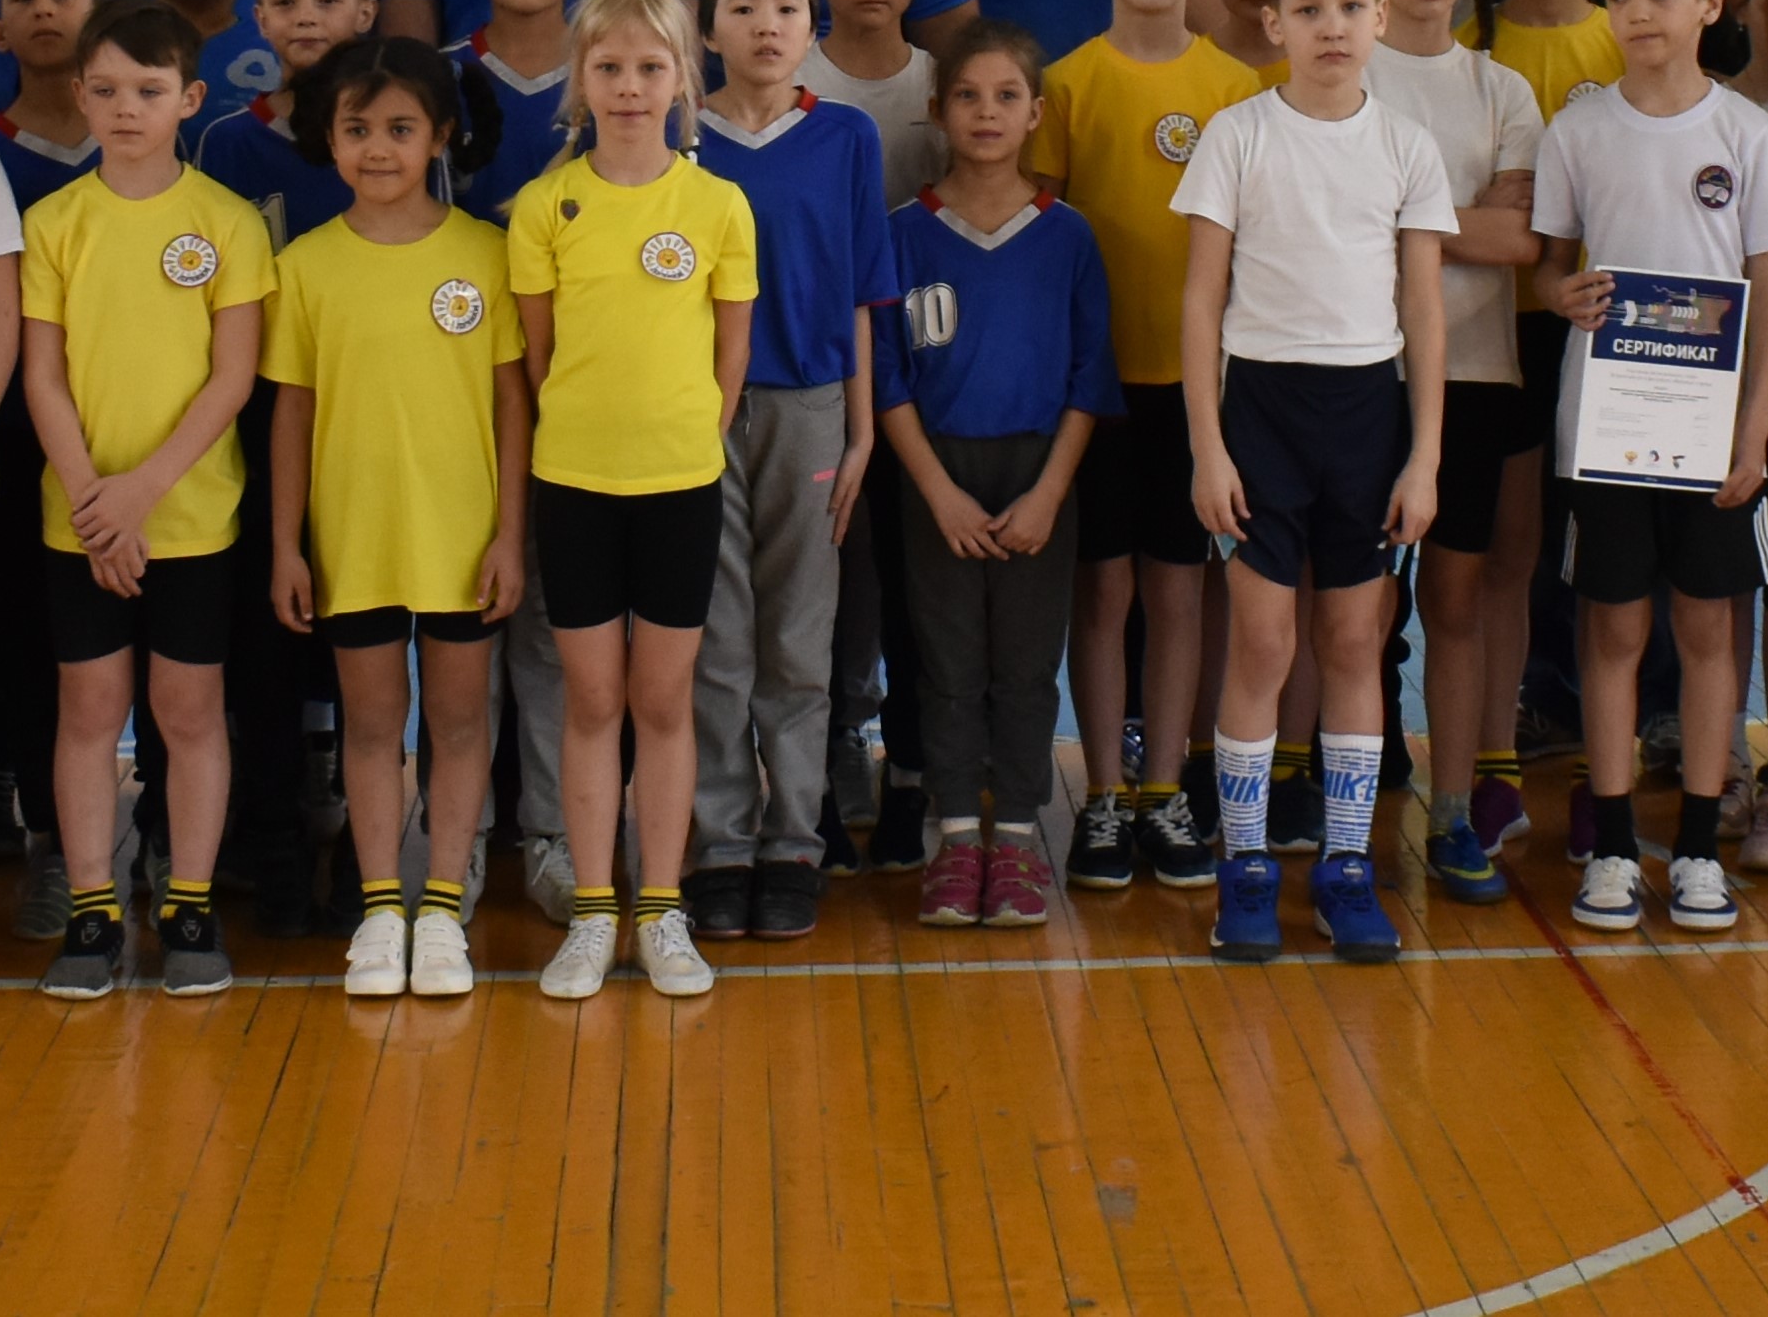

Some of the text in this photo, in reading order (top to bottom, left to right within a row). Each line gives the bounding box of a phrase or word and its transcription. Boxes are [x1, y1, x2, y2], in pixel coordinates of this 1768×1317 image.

[905, 282, 958, 350] 10
[1612, 338, 1719, 362] СЕРТИФИКАТ
[1220, 769, 1267, 803] NIK
